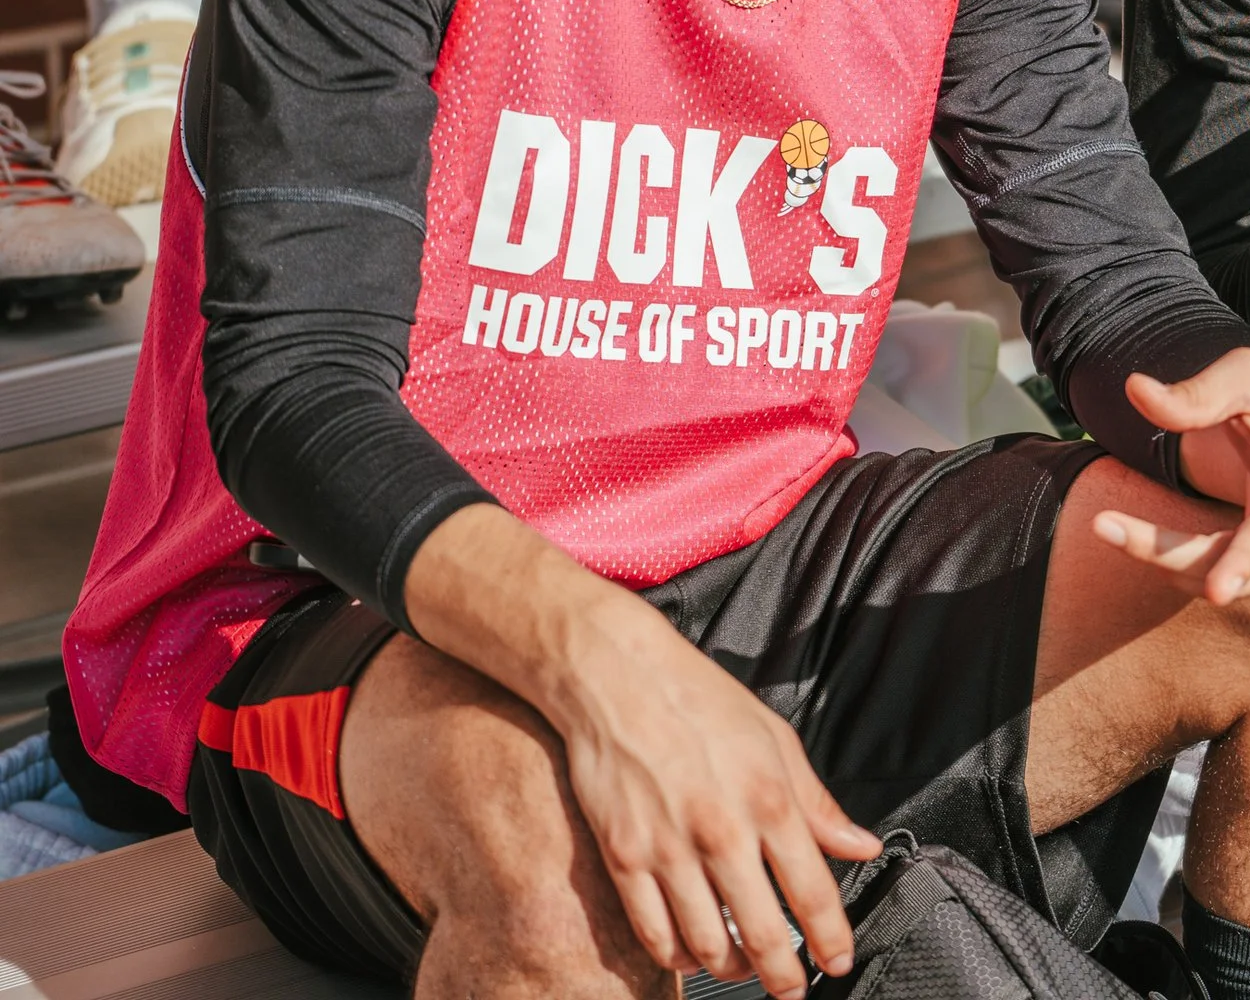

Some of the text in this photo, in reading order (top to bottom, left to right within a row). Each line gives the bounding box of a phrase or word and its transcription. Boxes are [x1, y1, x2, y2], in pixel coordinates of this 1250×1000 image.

[468, 109, 898, 297] DICK'S
[461, 284, 865, 371] HOUSE OF SPORT
